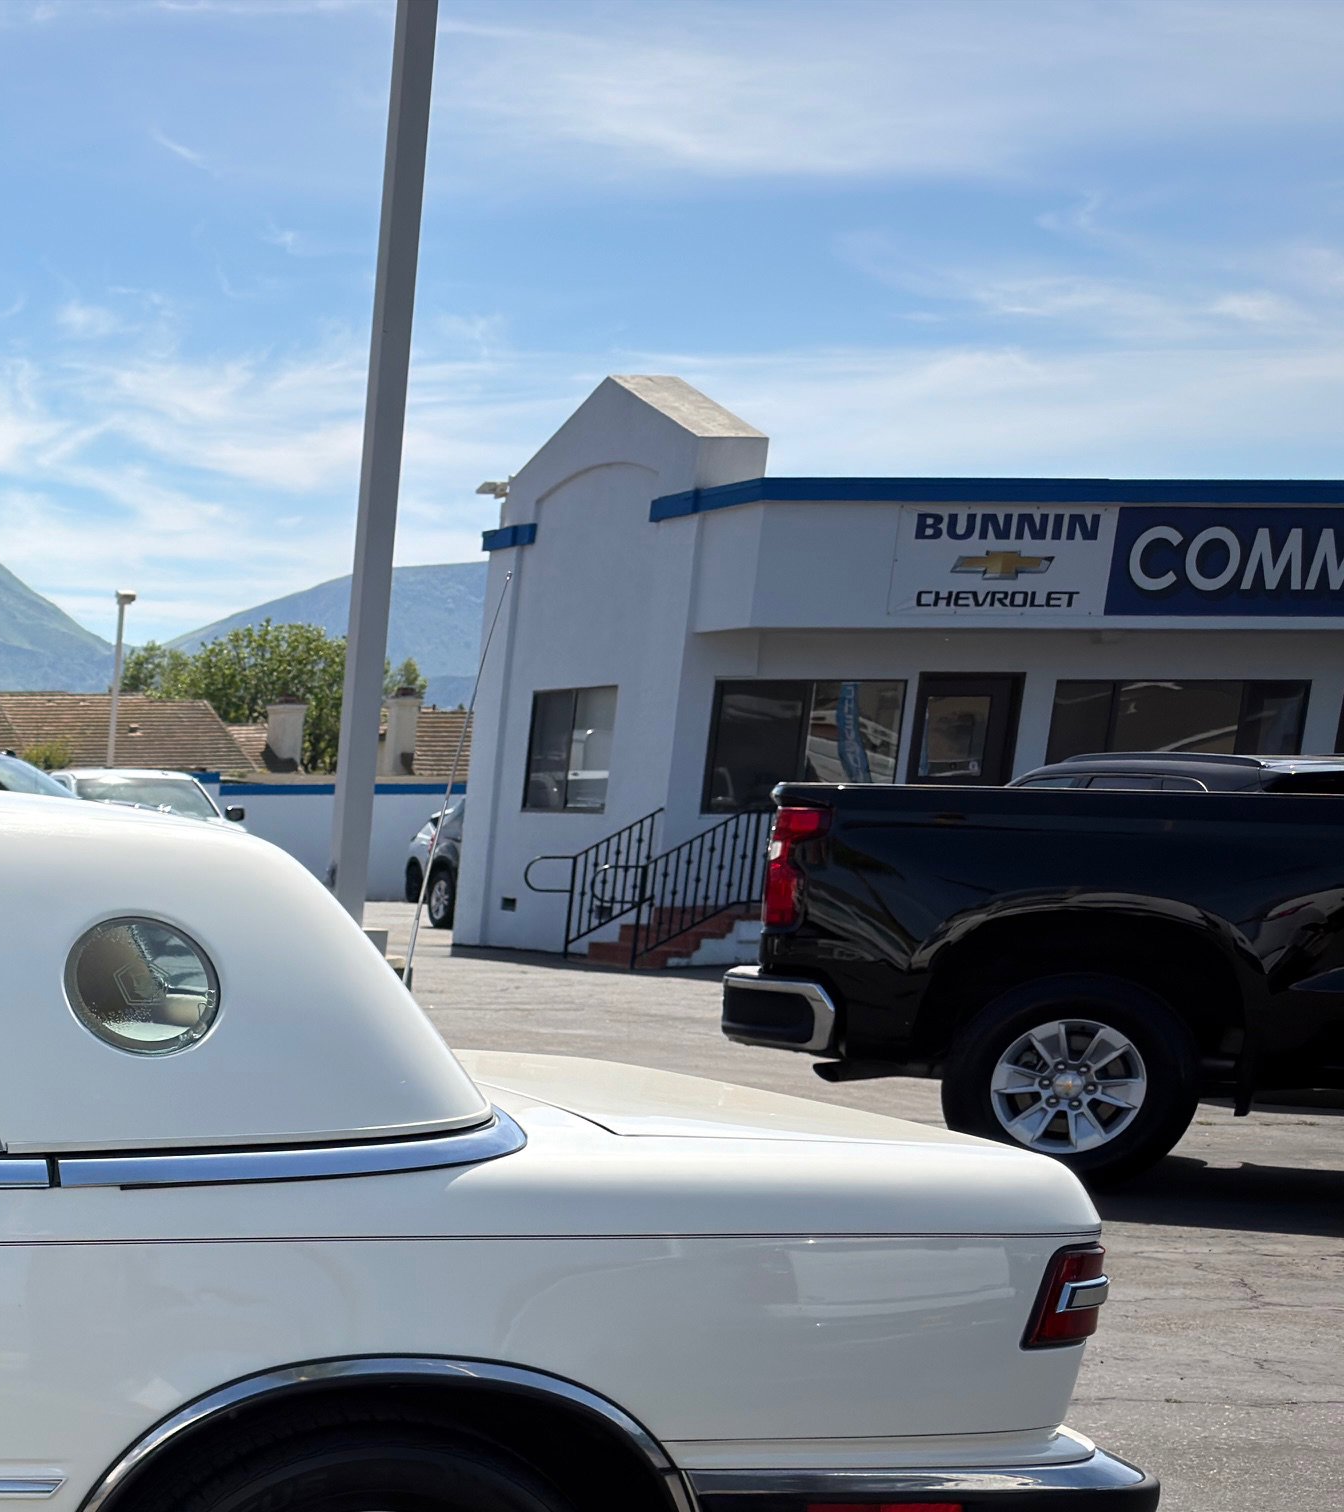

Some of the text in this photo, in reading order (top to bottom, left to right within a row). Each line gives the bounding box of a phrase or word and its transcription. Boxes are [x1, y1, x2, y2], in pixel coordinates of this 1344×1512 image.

[914, 512, 1102, 541] BUNNIN
[1128, 525, 1344, 592] COMM
[915, 590, 1080, 609] CHEVROLET
